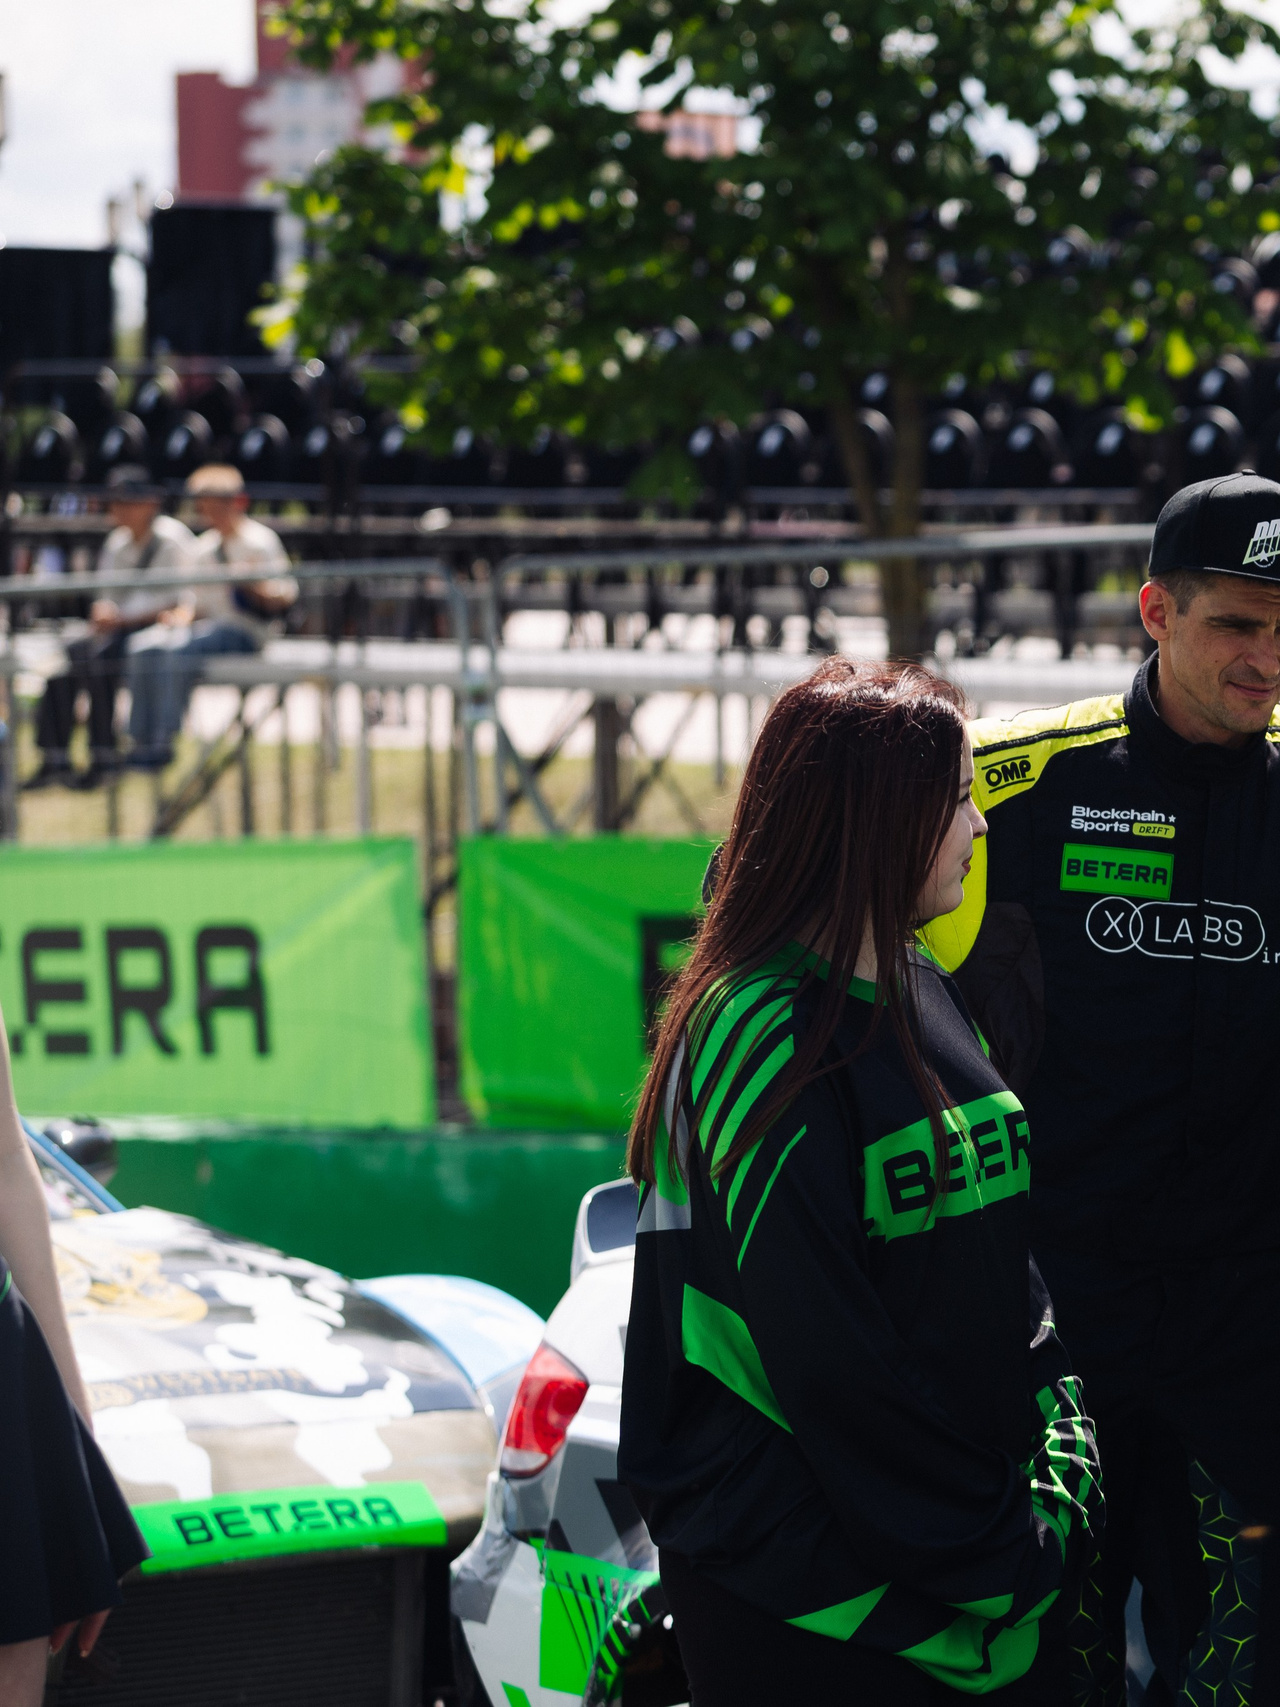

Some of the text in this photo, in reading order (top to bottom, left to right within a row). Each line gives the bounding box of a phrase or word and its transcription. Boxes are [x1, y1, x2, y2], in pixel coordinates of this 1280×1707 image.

[985, 759, 1031, 787] OMP
[1071, 818, 1170, 836] Sports DRIFT
[1072, 805, 1165, 822] Blockchain
[1103, 910, 1125, 938] X
[1155, 915, 1243, 946] LABS
[0, 924, 271, 1057] ERA
